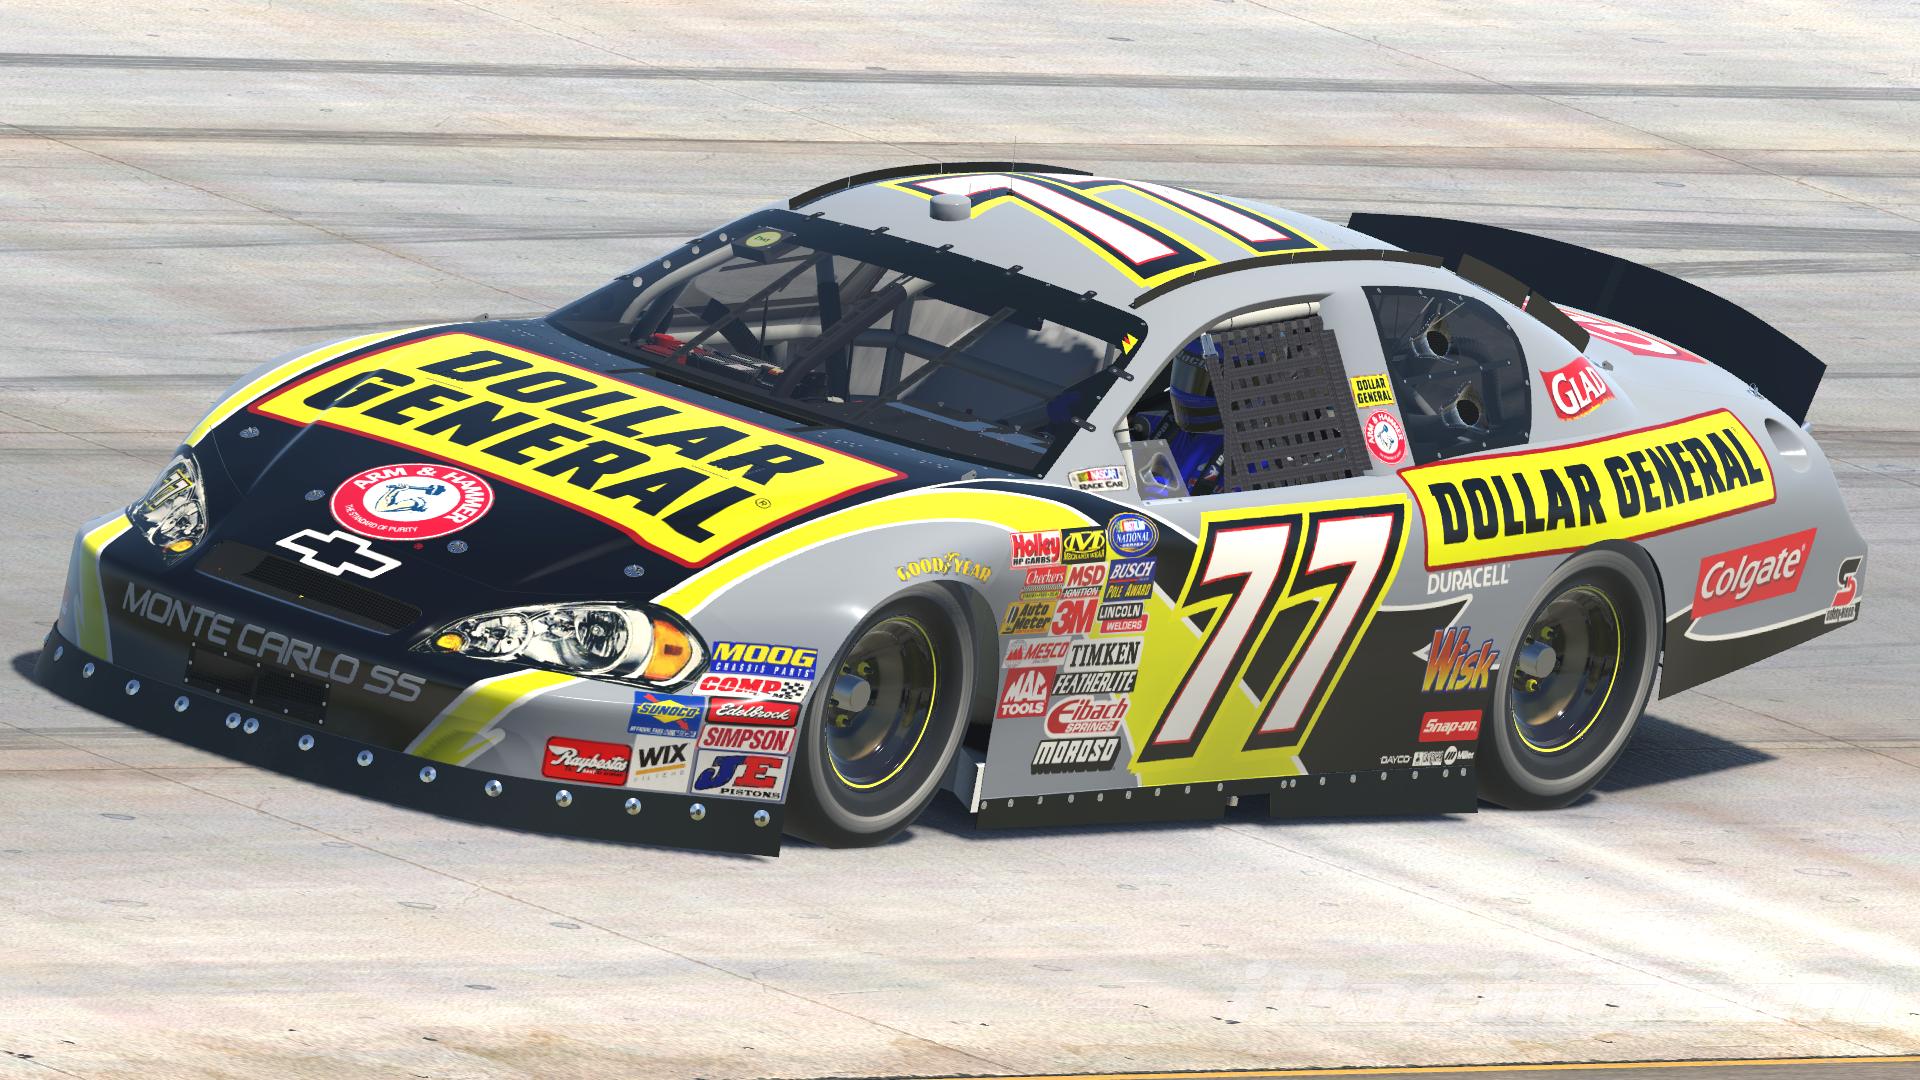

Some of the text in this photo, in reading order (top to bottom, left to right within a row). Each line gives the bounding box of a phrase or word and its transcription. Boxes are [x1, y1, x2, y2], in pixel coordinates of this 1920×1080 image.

[1356, 377, 1387, 391] DOLLAR
[1551, 366, 1607, 415] GLAD
[1357, 390, 1392, 404] GENERAL
[417, 348, 826, 486] DOLLAR
[1366, 423, 1376, 444] ARM
[303, 368, 741, 545] GENERAL
[353, 466, 485, 524] ARM & HAMMER
[1079, 482, 1104, 490] RACE
[1428, 429, 1764, 545] DOLLAR GENERAL
[1011, 533, 1060, 563] Holley
[1116, 532, 1150, 544] NATIONAL
[1026, 569, 1064, 584] Checkers
[1067, 565, 1106, 587] MSD
[1109, 561, 1155, 579] BUSCH
[1427, 564, 1509, 595] DURACELL
[1701, 547, 1801, 600] Colgate
[1063, 587, 1100, 598] IGNITION
[1105, 583, 1152, 599] POLE AWARD
[1020, 604, 1049, 617] Auto
[1051, 600, 1099, 635] 3M
[1099, 604, 1141, 619] LINCOLN
[1014, 617, 1051, 630] Meter
[1105, 621, 1143, 631] WELDERS
[1147, 509, 1400, 750] 77
[122, 581, 427, 702] MONTE CARLO SS
[1024, 641, 1071, 660] MESCO
[712, 643, 818, 668] MOOG
[1069, 641, 1141, 667] TIMKEN
[1421, 625, 1500, 692] Wisk
[715, 662, 810, 678] CHASSIS PARTS
[699, 676, 782, 695] COMP
[1003, 669, 1048, 704] MAC
[1052, 671, 1137, 695] FEATHERLITE
[640, 703, 698, 718] SUNOCO
[715, 702, 791, 721] Edelbrock
[1002, 702, 1045, 716] TOOLS
[1047, 698, 1129, 727] Eibach
[1065, 721, 1114, 734] SPRINGS
[1423, 718, 1477, 735] Snap-on
[703, 726, 790, 751] SIMPSON
[638, 742, 689, 768] WIX
[1032, 738, 1120, 767] MOROSO
[1380, 755, 1411, 765] DAYCO
[694, 754, 784, 791] JE
[719, 787, 781, 799] PISTONS
